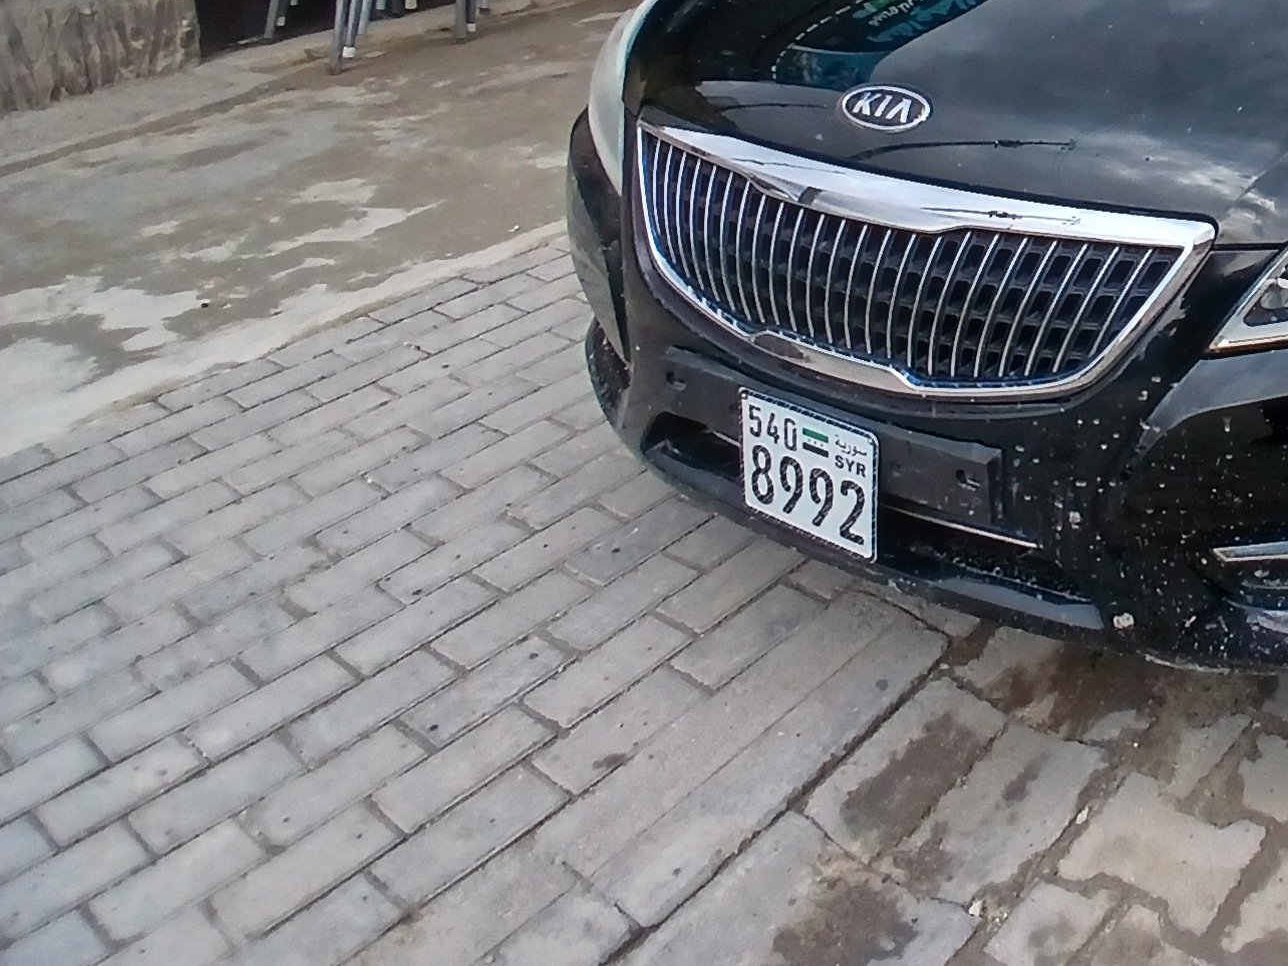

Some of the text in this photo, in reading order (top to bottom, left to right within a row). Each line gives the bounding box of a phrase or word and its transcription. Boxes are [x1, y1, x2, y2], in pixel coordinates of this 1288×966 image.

[851, 91, 912, 124] KIA
[748, 404, 798, 452] 540
[834, 433, 868, 457] سورية
[834, 454, 867, 478] SYR
[751, 444, 866, 546] 8992
